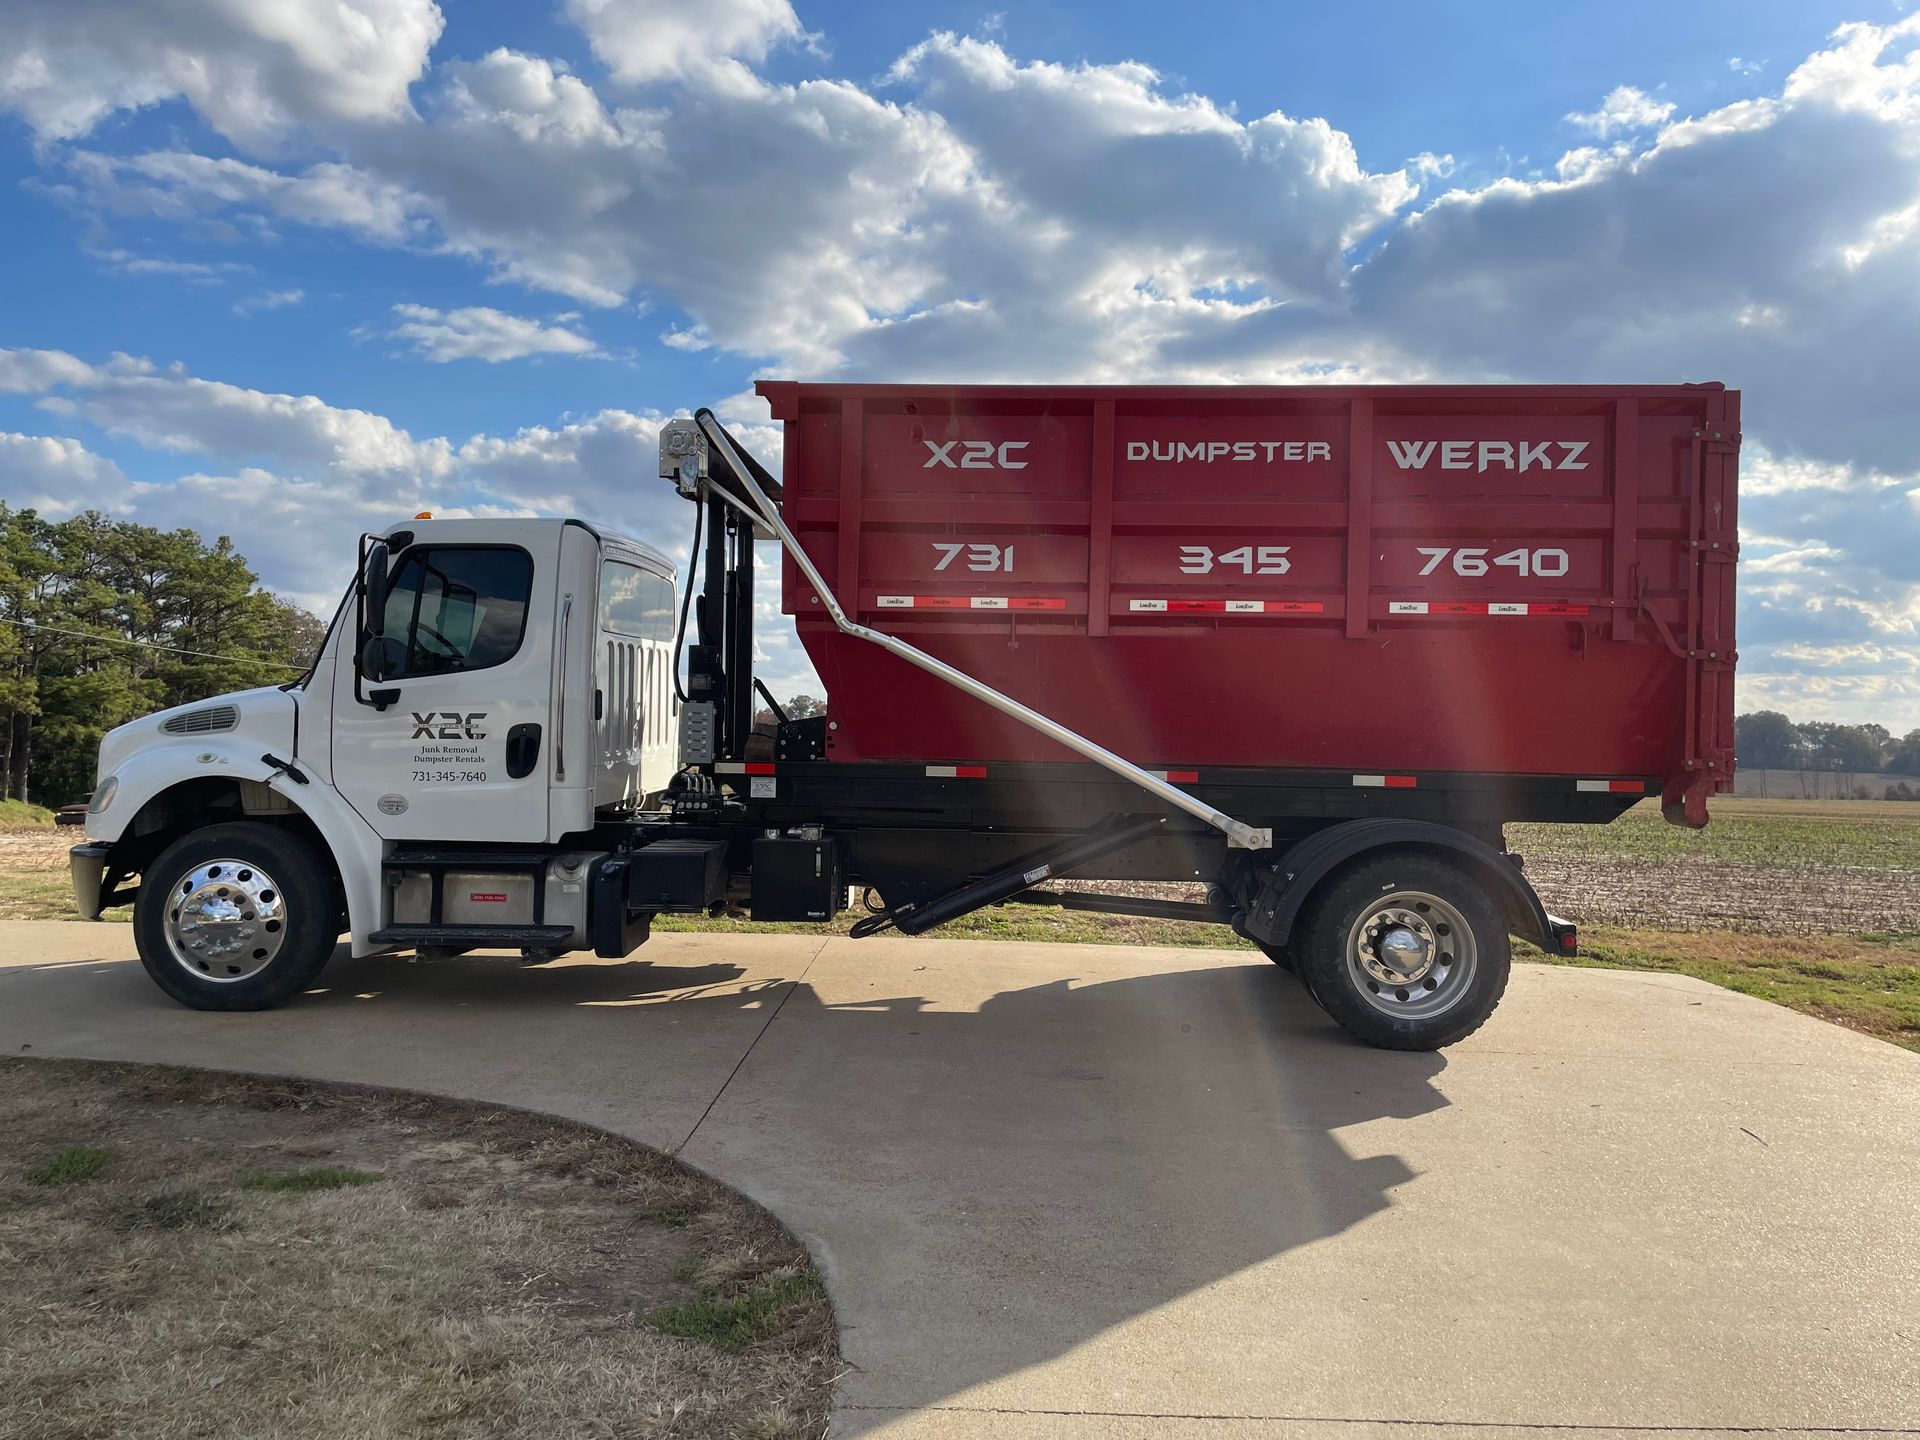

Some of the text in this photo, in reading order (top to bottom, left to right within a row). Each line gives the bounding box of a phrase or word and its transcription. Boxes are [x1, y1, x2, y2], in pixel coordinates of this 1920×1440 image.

[922, 439, 1590, 474] X2C DUMPSTER WERKZ
[932, 543, 1569, 577] 731 345 7640
[411, 712, 488, 739] X2C
[421, 746, 441, 754] Junk
[414, 756, 453, 764] Dumpster
[412, 771, 487, 782] 731-345-7640
